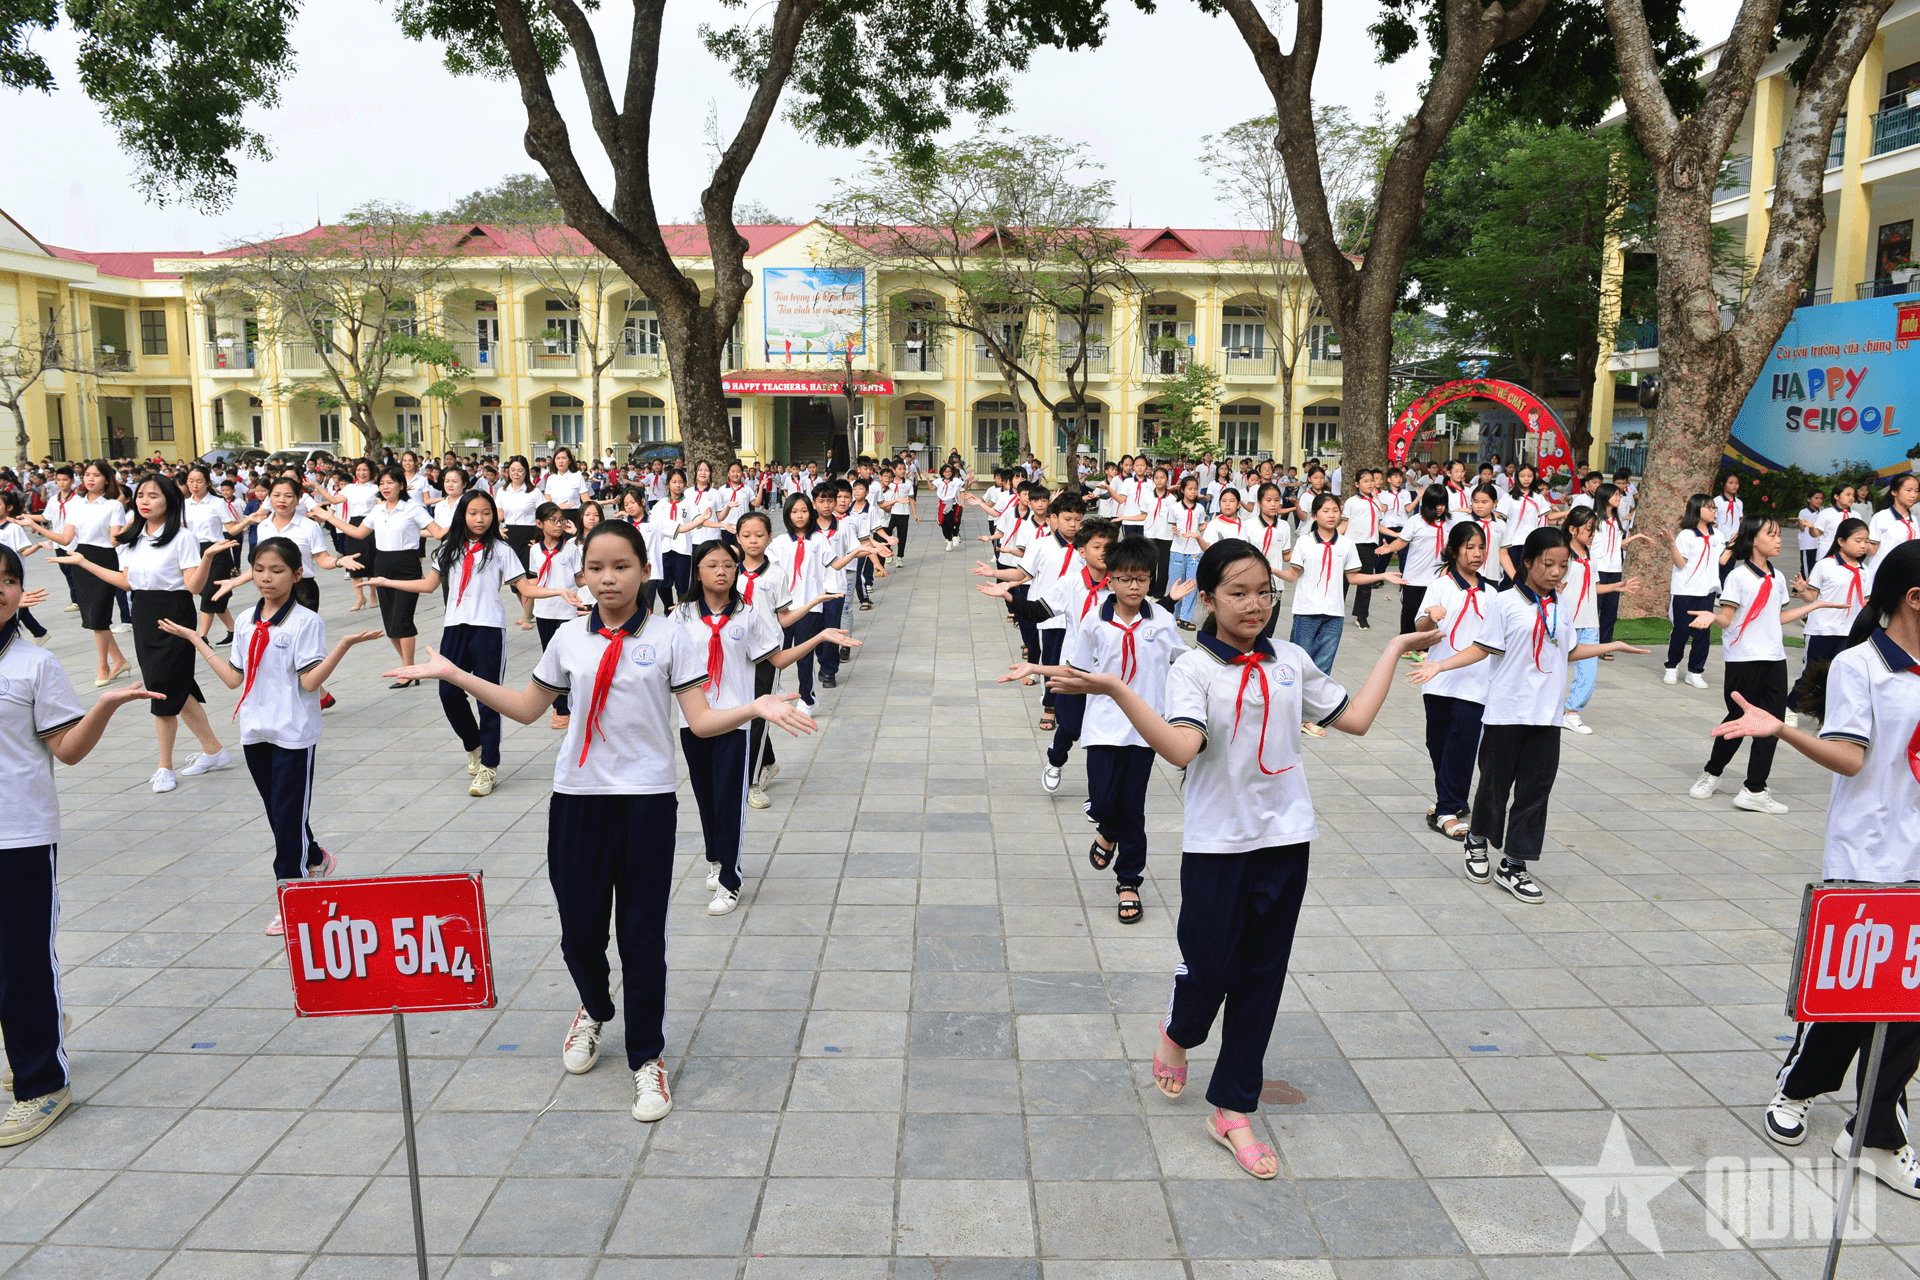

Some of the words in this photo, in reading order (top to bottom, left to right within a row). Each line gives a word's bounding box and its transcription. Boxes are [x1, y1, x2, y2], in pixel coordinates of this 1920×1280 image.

[1810, 342, 1840, 359] trường
[1843, 338, 1860, 355] của
[1862, 337, 1892, 355] chúng
[732, 382, 760, 391] HAPPY
[762, 383, 809, 392] TEACHERS,
[810, 383, 838, 392] HAPPY
[1771, 366, 1868, 402] HAPPY
[1785, 405, 1901, 436] SCHOOL
[298, 903, 378, 981] LỚP
[1816, 903, 1894, 990] LỚP
